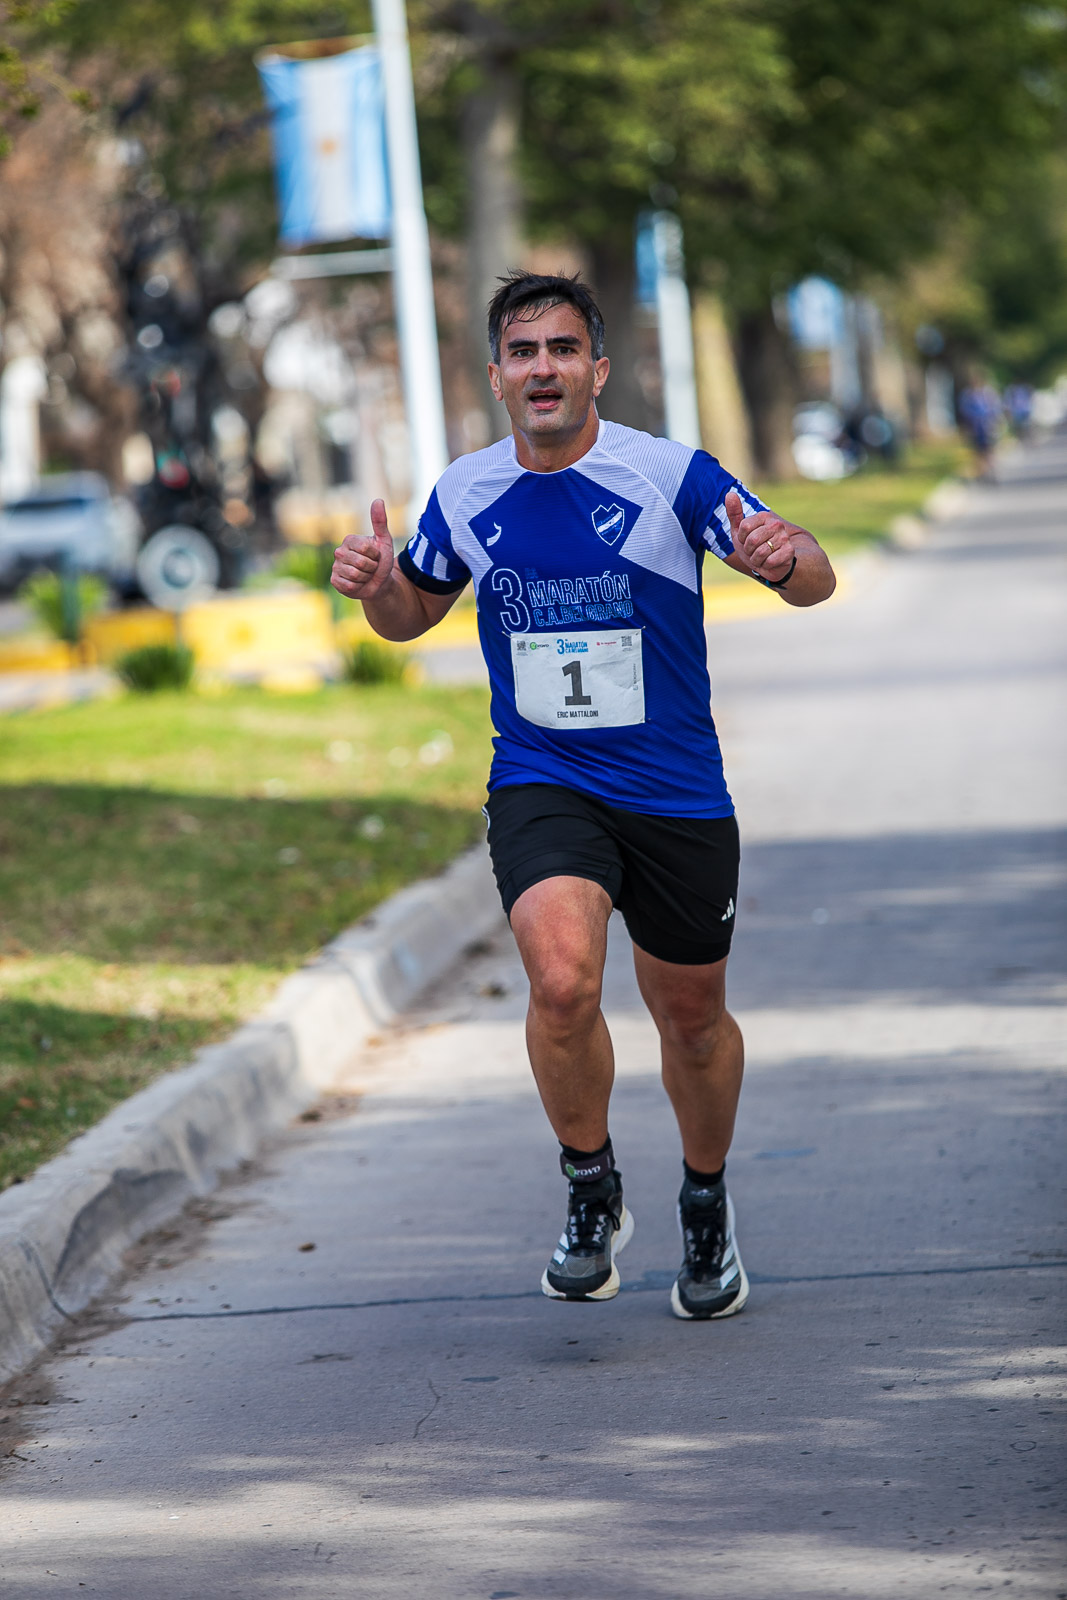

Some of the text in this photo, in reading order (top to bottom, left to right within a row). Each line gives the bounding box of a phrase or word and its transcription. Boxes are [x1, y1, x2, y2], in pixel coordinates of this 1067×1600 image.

[491, 567, 632, 634] 3 MARATÓN
[556, 638, 565, 655] 3
[562, 660, 592, 706] 1
[569, 710, 599, 718] MATTALONI
